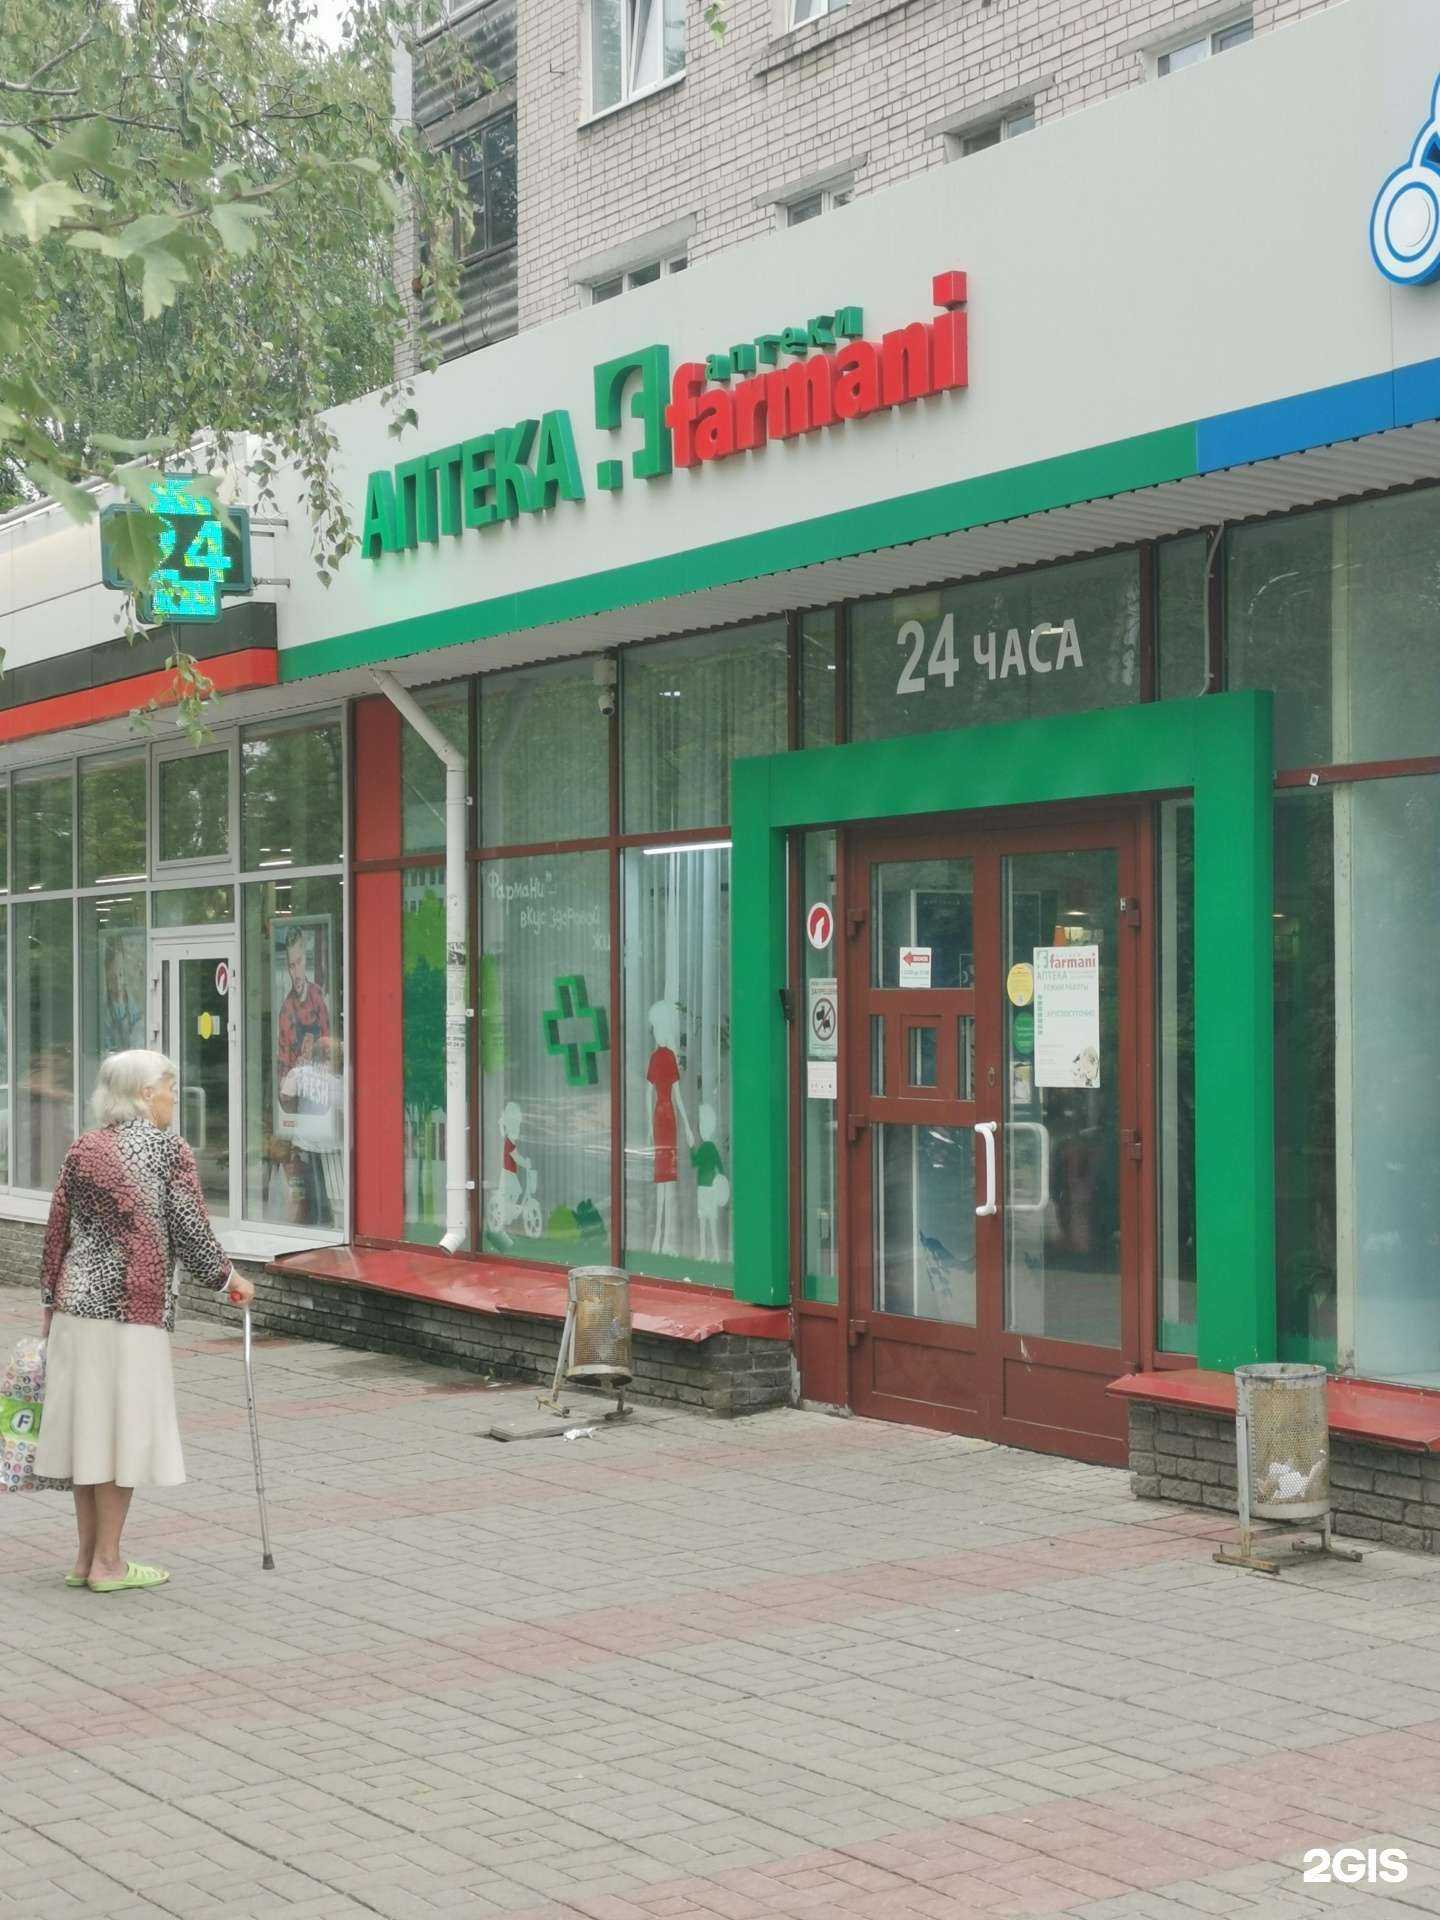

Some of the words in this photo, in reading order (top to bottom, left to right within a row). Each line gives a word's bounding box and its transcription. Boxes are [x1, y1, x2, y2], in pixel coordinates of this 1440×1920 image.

[665, 270, 968, 468] farmani
[706, 306, 863, 381] аптеки
[361, 409, 585, 559] АПТЕКА
[896, 612, 960, 695] 24
[973, 617, 1085, 681] ЧАСА
[1050, 952, 1096, 969] farmani
